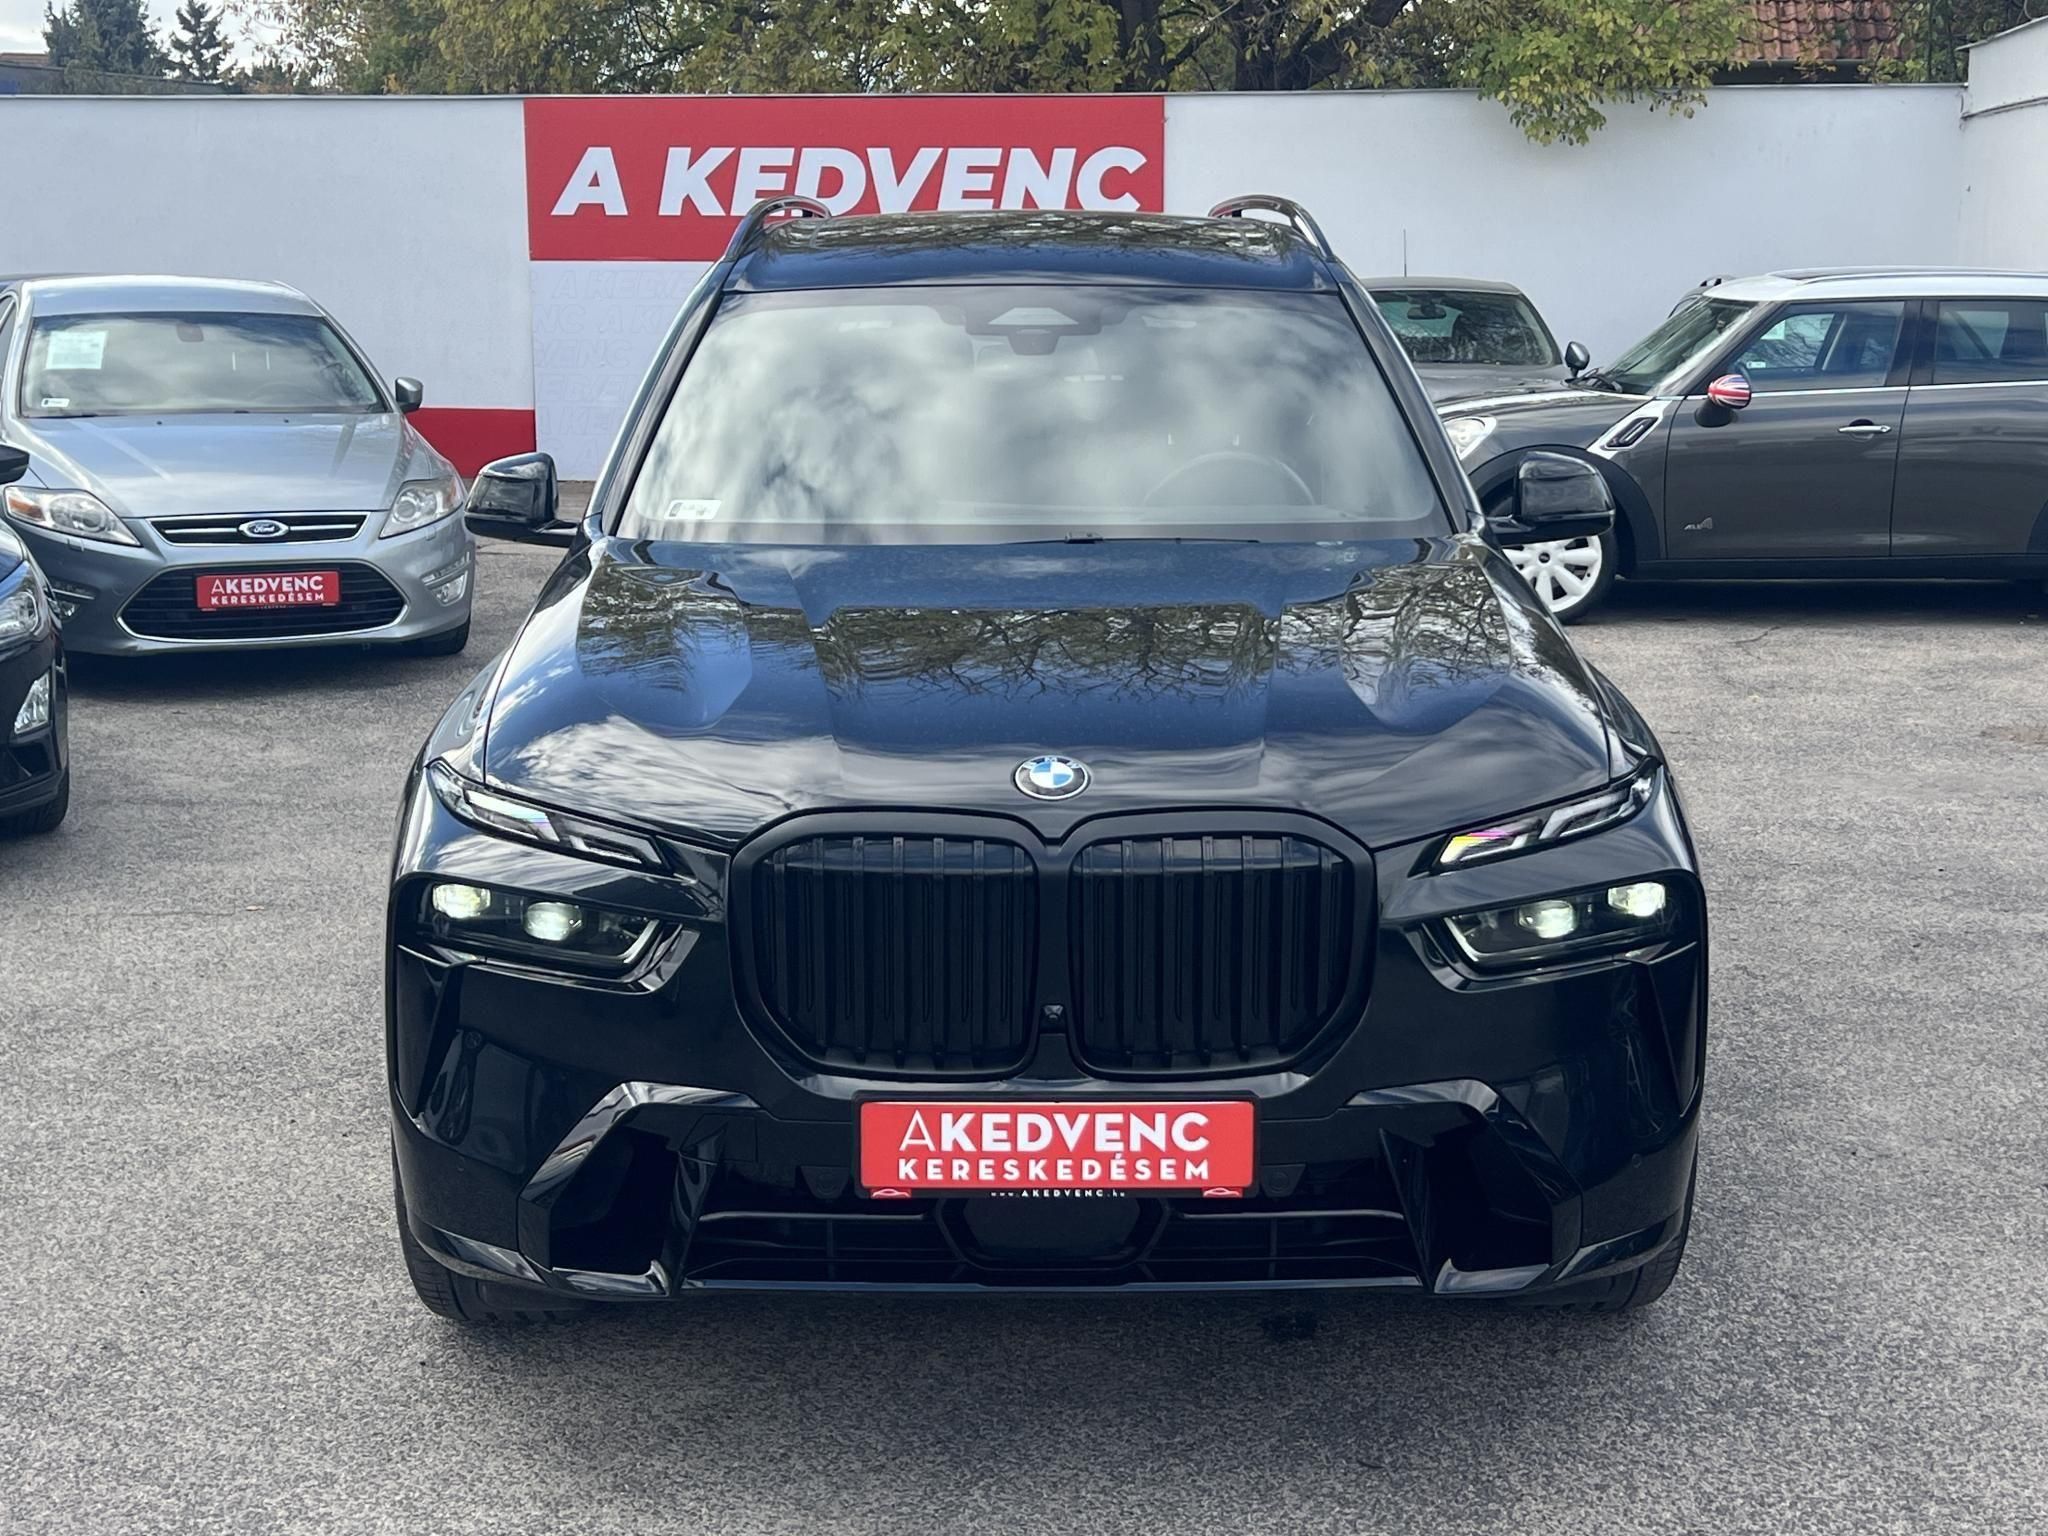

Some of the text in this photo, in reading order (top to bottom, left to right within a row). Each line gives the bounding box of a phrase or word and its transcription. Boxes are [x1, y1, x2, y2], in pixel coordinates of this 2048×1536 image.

[551, 147, 1148, 216] A KEDVENC
[253, 523, 275, 534] Ford
[211, 592, 324, 606] KERESKEDÉSEM
[899, 1152, 1209, 1181] KERESKEDÉSEM
